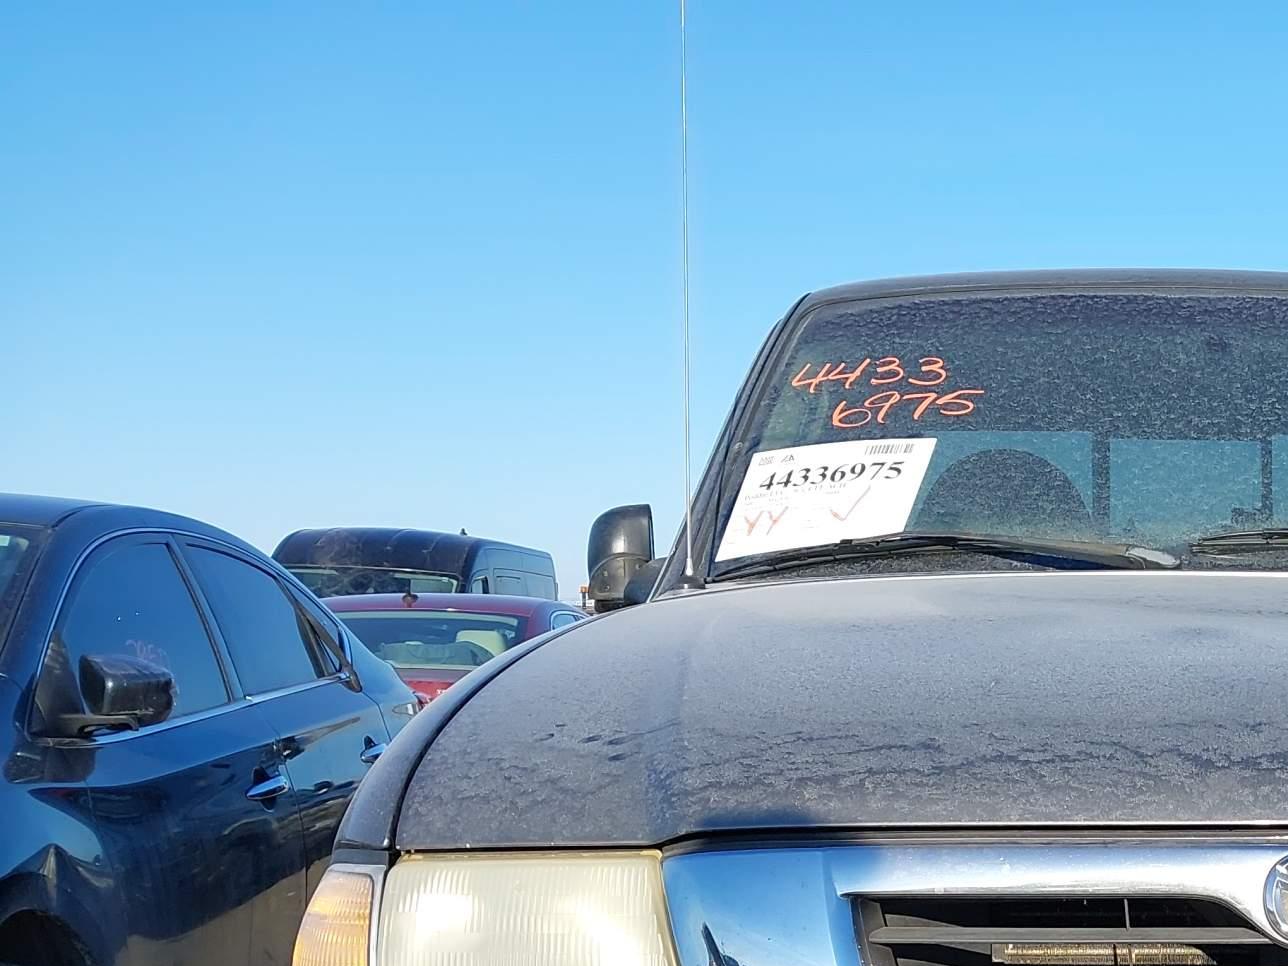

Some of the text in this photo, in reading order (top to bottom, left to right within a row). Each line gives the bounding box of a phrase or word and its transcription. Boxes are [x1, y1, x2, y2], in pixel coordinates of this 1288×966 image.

[791, 356, 947, 394] 4433
[832, 389, 985, 428] 6975
[758, 460, 905, 491] 44336975
